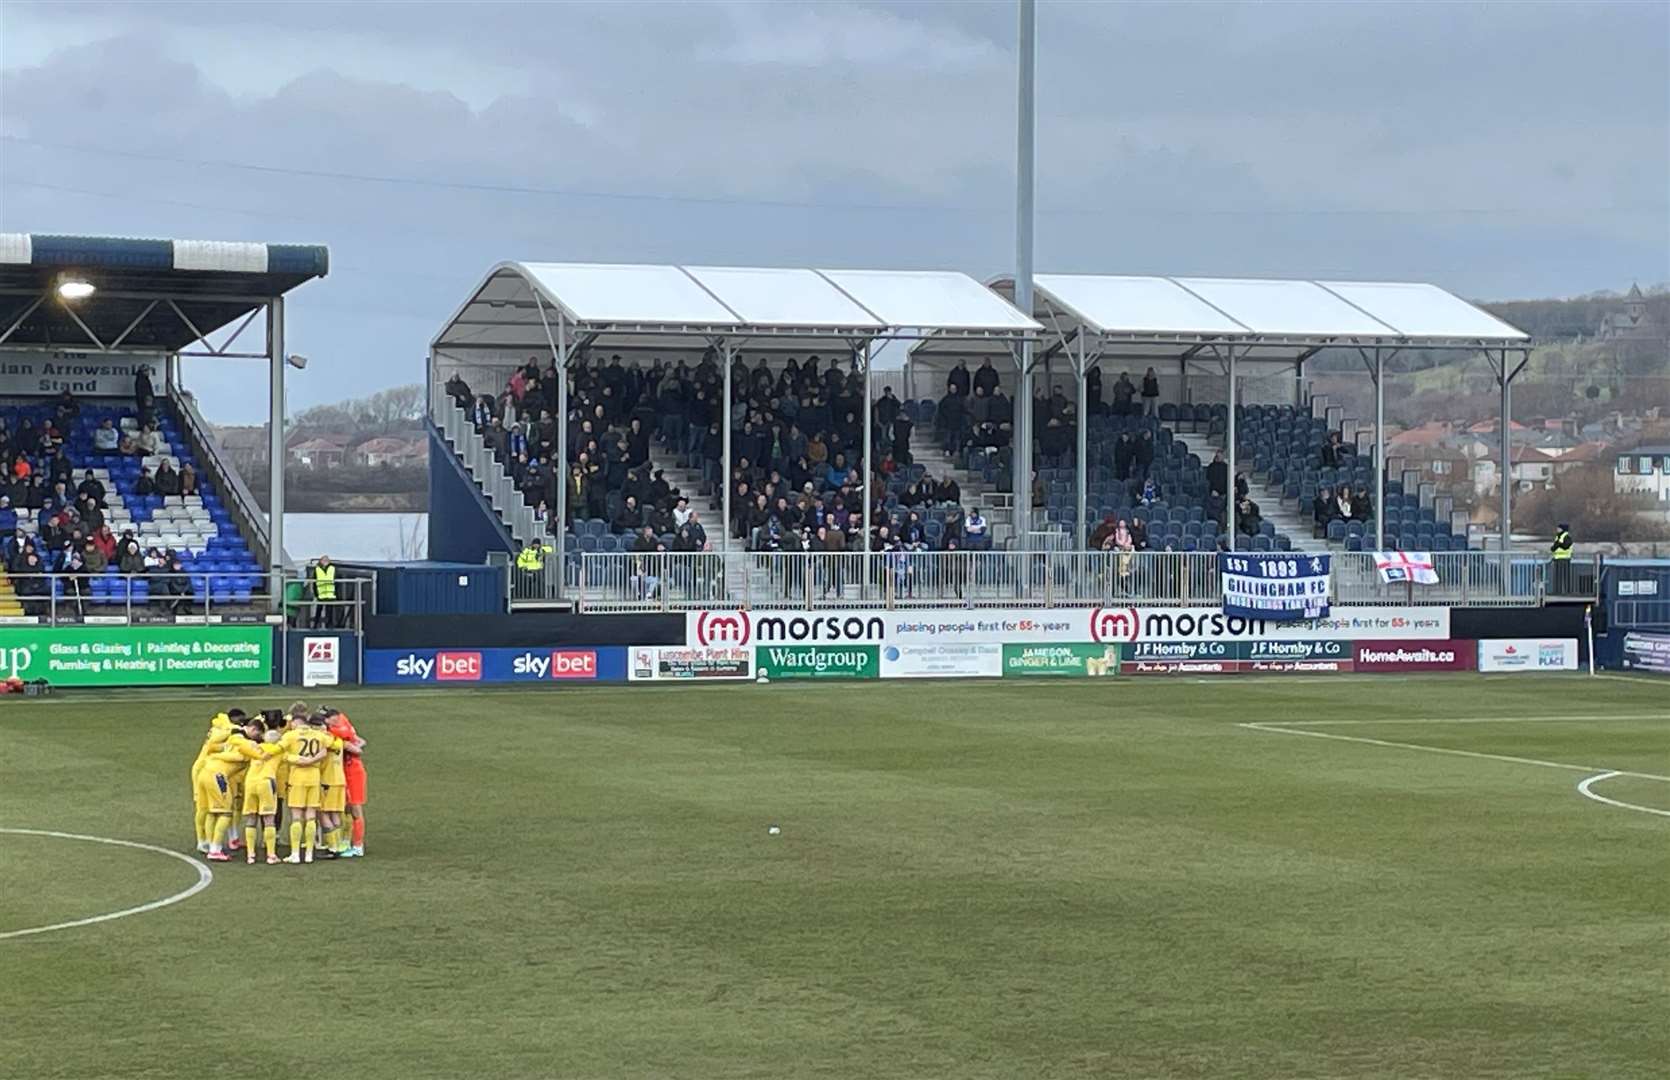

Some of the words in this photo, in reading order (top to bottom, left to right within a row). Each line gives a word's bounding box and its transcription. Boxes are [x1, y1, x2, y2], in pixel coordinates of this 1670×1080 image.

[39, 380, 96, 391] Stand
[1227, 558, 1248, 572] EST
[1260, 560, 1297, 577] 1893
[1228, 578, 1305, 597] GILLINGHAM
[1311, 580, 1325, 594] FC
[757, 617, 884, 640] morson
[896, 621, 935, 634] placing
[938, 621, 975, 634] people
[978, 621, 999, 631] first
[1002, 620, 1017, 631] for
[1042, 622, 1070, 632] years
[1146, 614, 1265, 636] morson
[1315, 618, 1350, 630] people
[1352, 617, 1373, 627] first
[1375, 617, 1389, 627] for
[1413, 618, 1439, 630] years
[49, 643, 78, 654] Glass
[80, 643, 90, 654] &
[92, 643, 131, 656] Glazing
[147, 642, 190, 655] Painting
[192, 642, 202, 653] &
[204, 641, 260, 655] Decorating
[1134, 643, 1140, 655] J
[1144, 643, 1151, 654] F
[1153, 642, 1197, 657] Hornby
[1199, 642, 1207, 654] &
[1210, 642, 1225, 654] Co
[1251, 642, 1257, 654] J
[1260, 642, 1267, 653] F
[1269, 641, 1313, 656] Hornby
[1314, 642, 1323, 653] &
[1325, 642, 1340, 654] Co
[1360, 648, 1454, 662] HomeAwaits.ca
[49, 659, 100, 672] Plumbing
[103, 659, 112, 670] &
[115, 658, 156, 671] Heating
[167, 658, 224, 671] Decorating
[225, 657, 260, 669] Centre
[397, 654, 434, 679] sky
[441, 656, 477, 674] bet
[513, 653, 550, 678] sky
[556, 654, 592, 672] bet
[769, 647, 868, 671] Wardgroup
[1009, 657, 1048, 667] GINGER
[298, 738, 320, 757] 20
